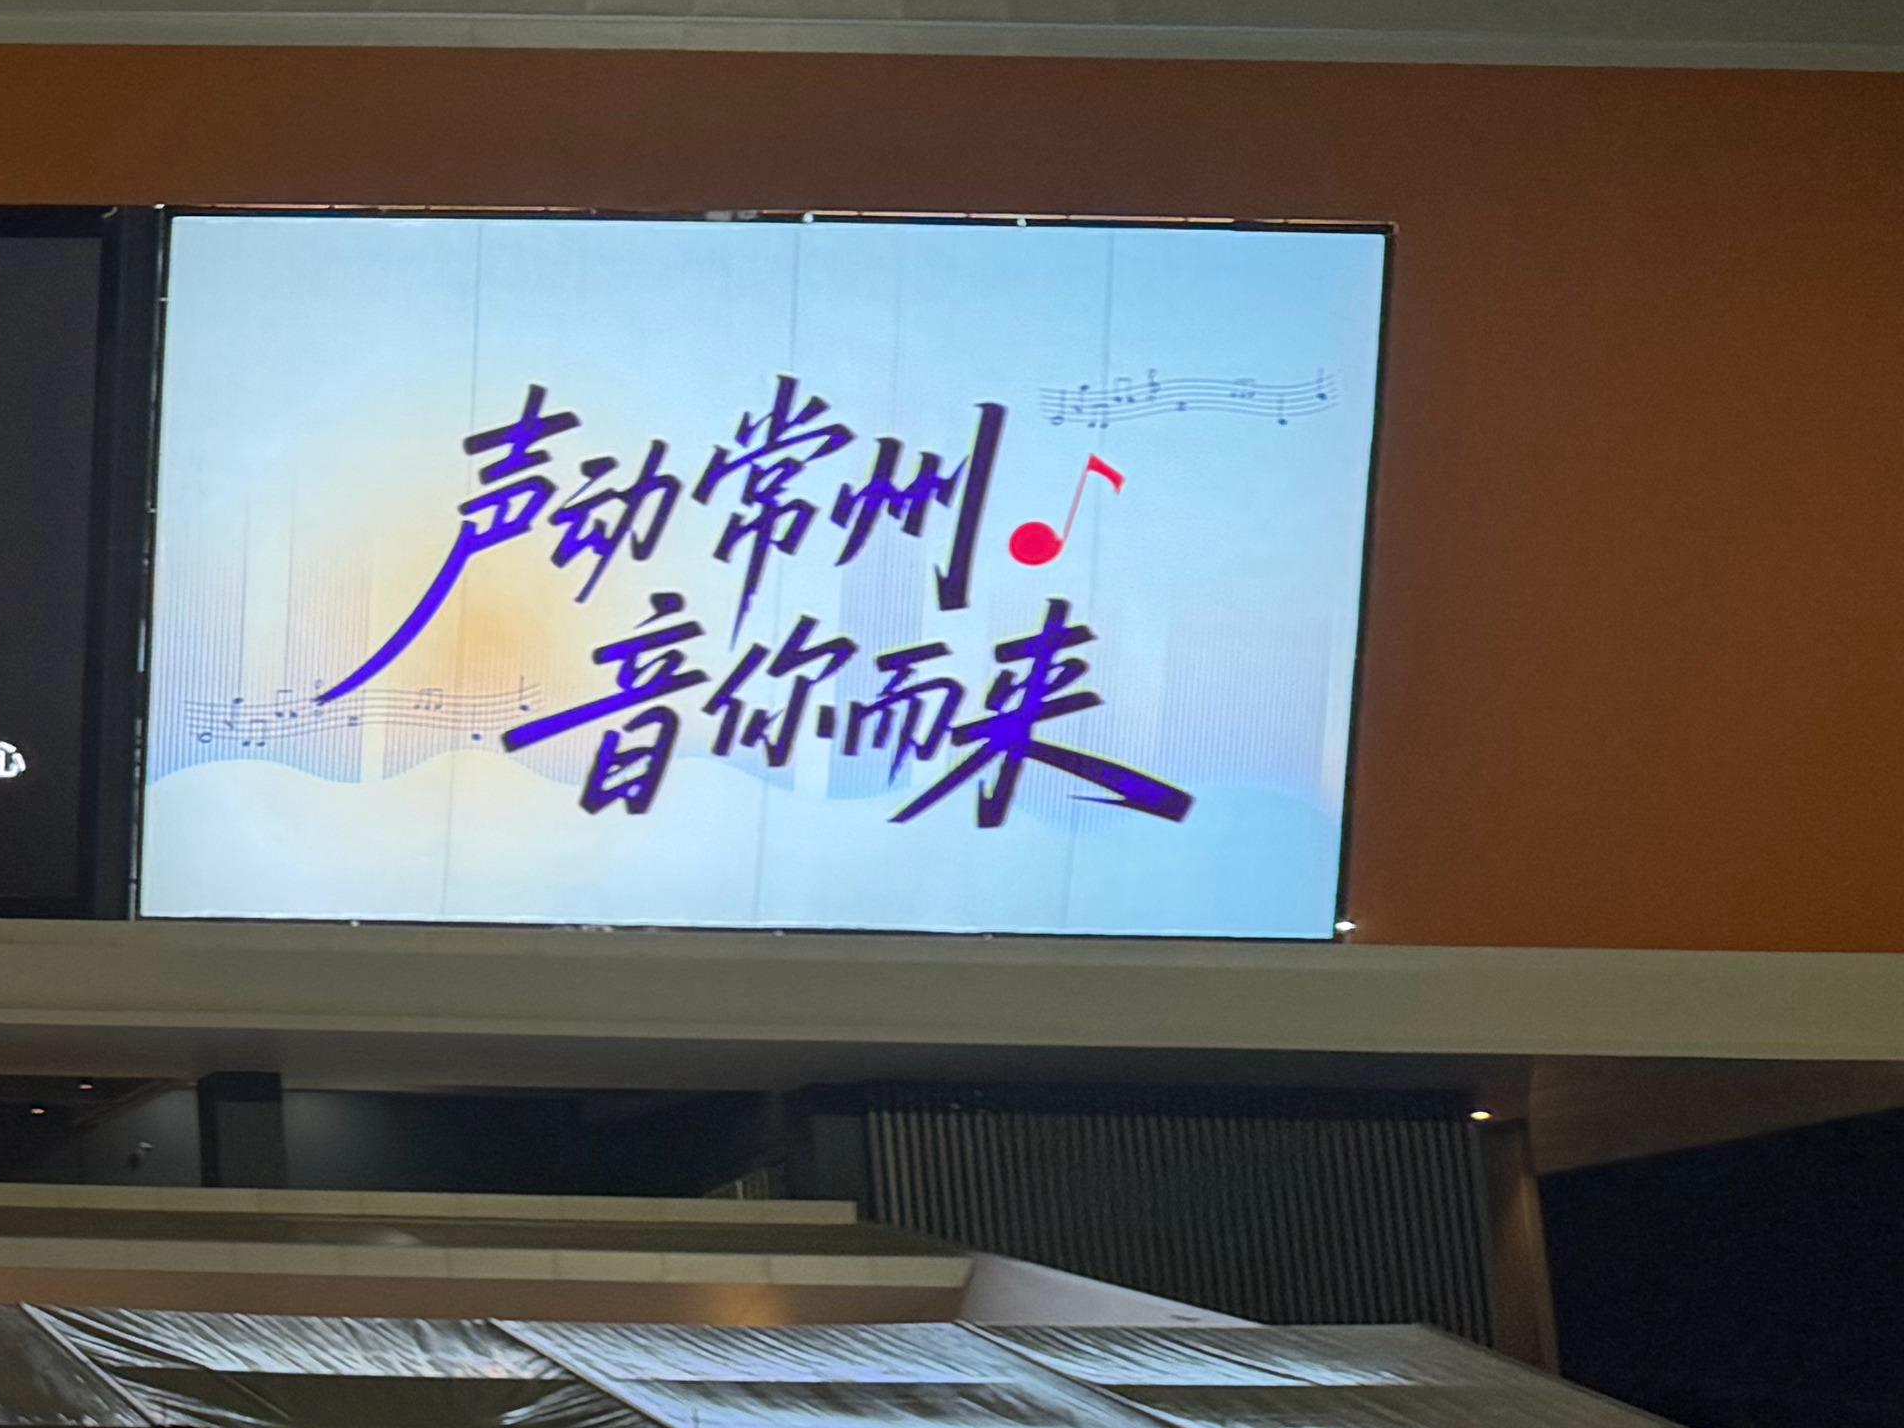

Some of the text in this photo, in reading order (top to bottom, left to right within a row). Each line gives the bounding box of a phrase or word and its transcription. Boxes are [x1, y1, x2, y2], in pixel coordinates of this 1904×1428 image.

[314, 375, 1008, 707] 声动常州
[501, 592, 1196, 829] 音你而来
